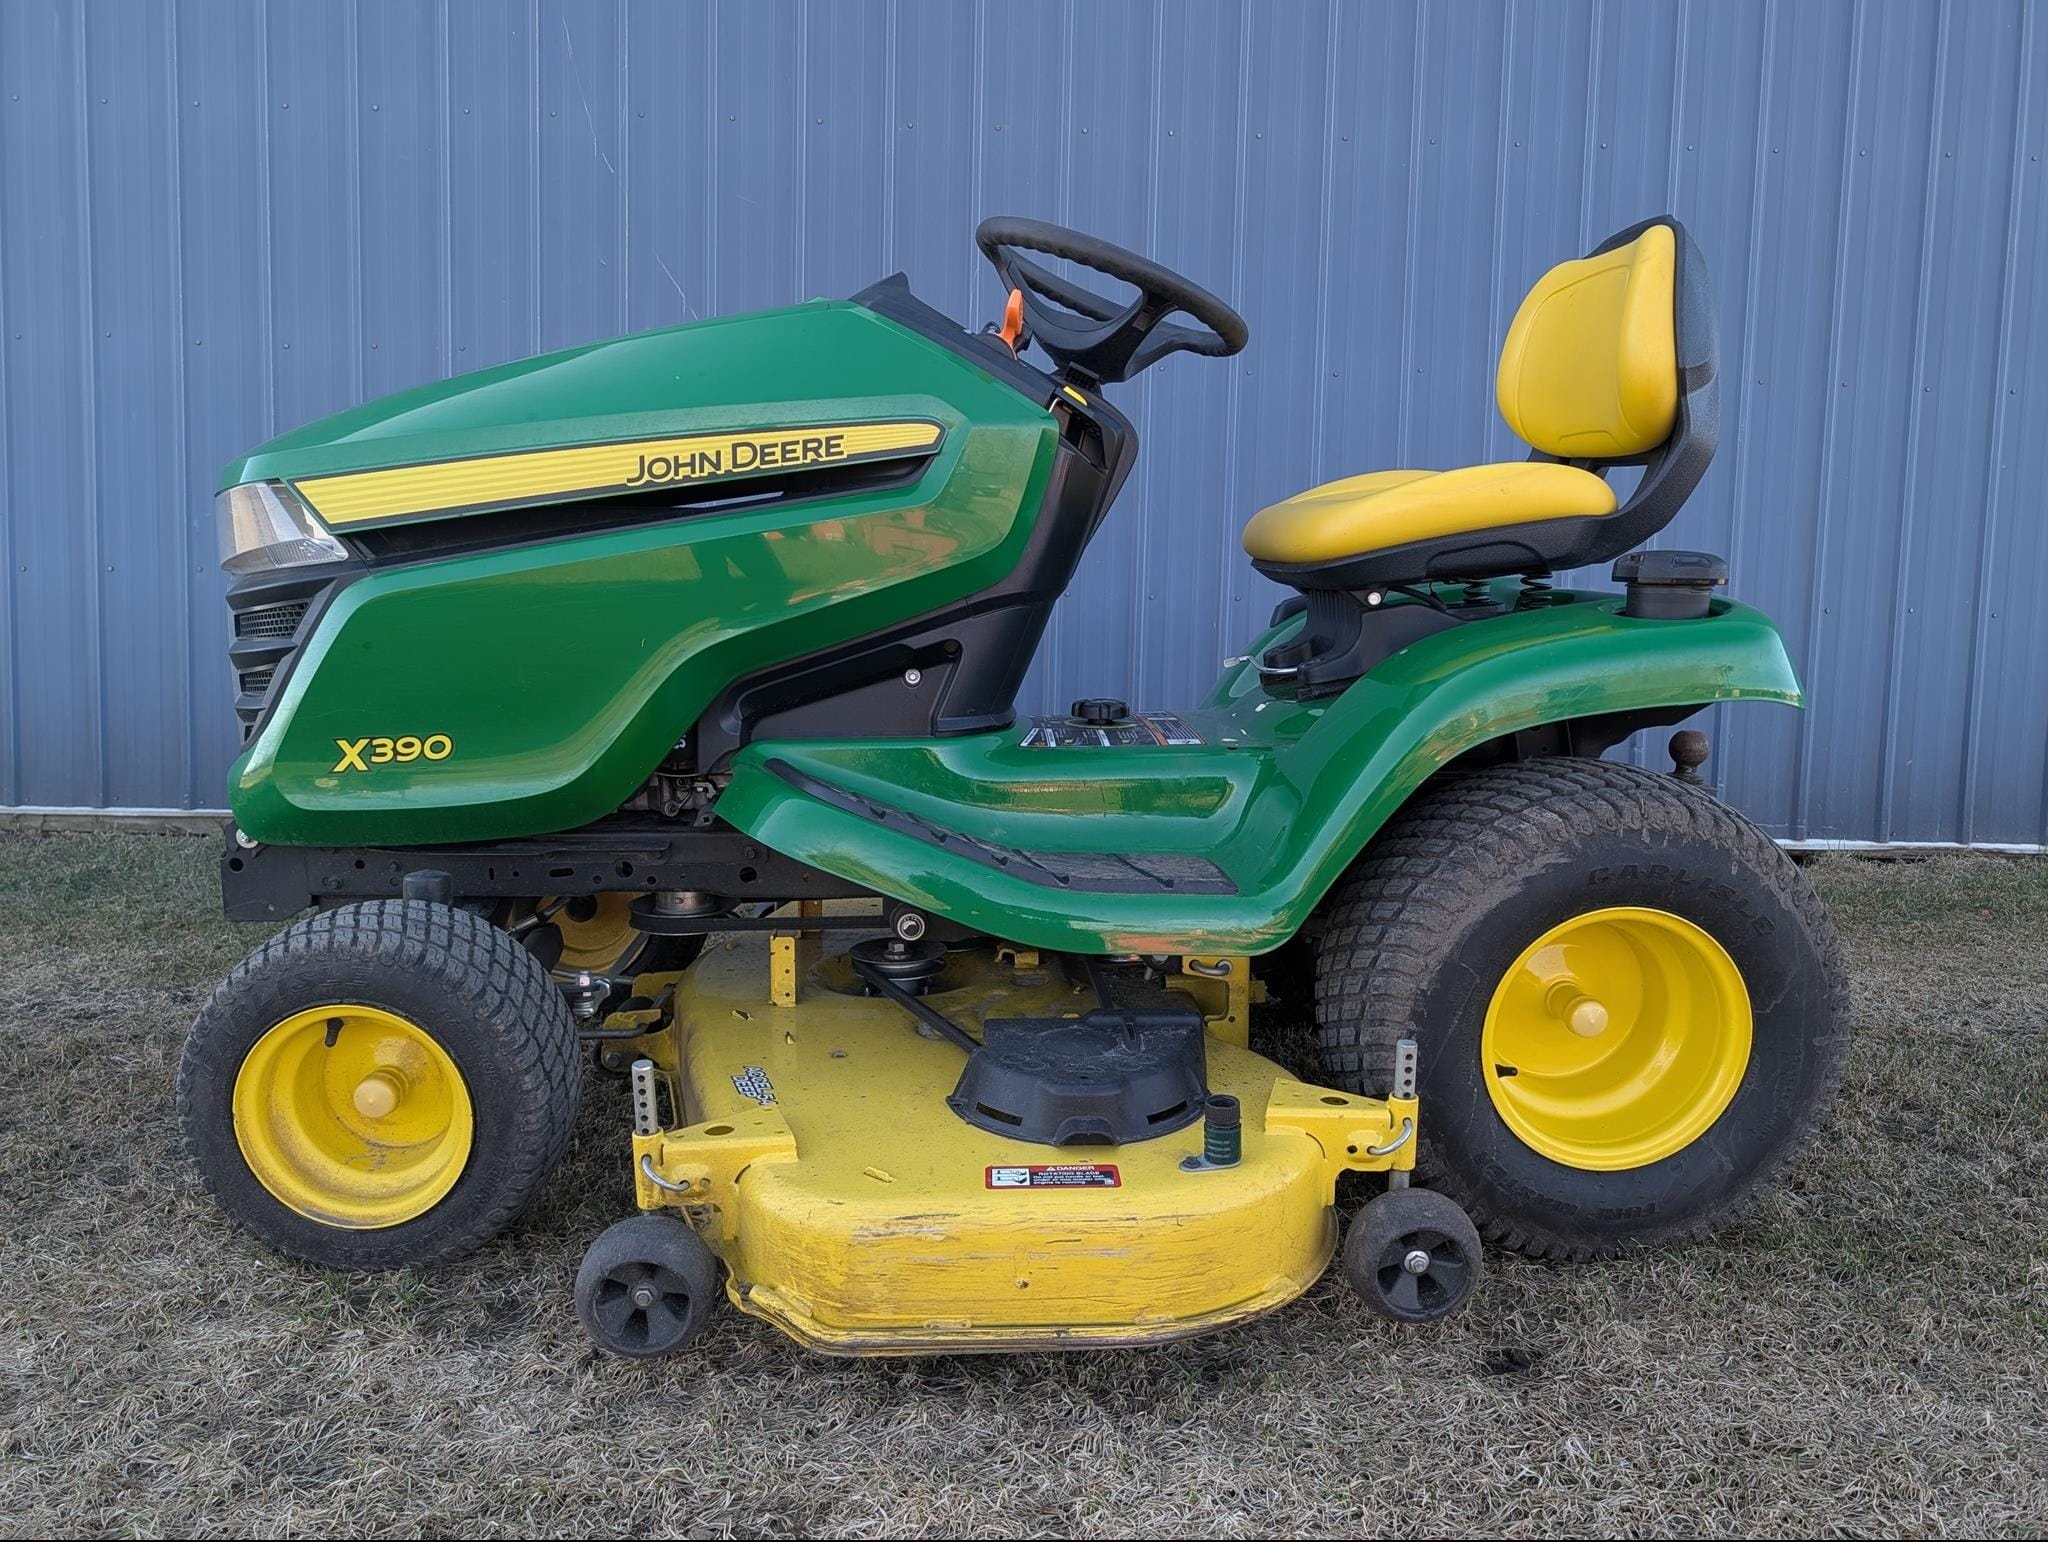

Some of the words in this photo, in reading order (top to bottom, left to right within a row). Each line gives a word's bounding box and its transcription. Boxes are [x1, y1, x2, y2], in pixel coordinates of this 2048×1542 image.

[626, 450, 722, 485] JOHN
[731, 434, 845, 470] DEERE
[332, 733, 453, 773] X390
[1588, 863, 1776, 937] CARLISLE
[731, 1075, 757, 1098] DEEP
